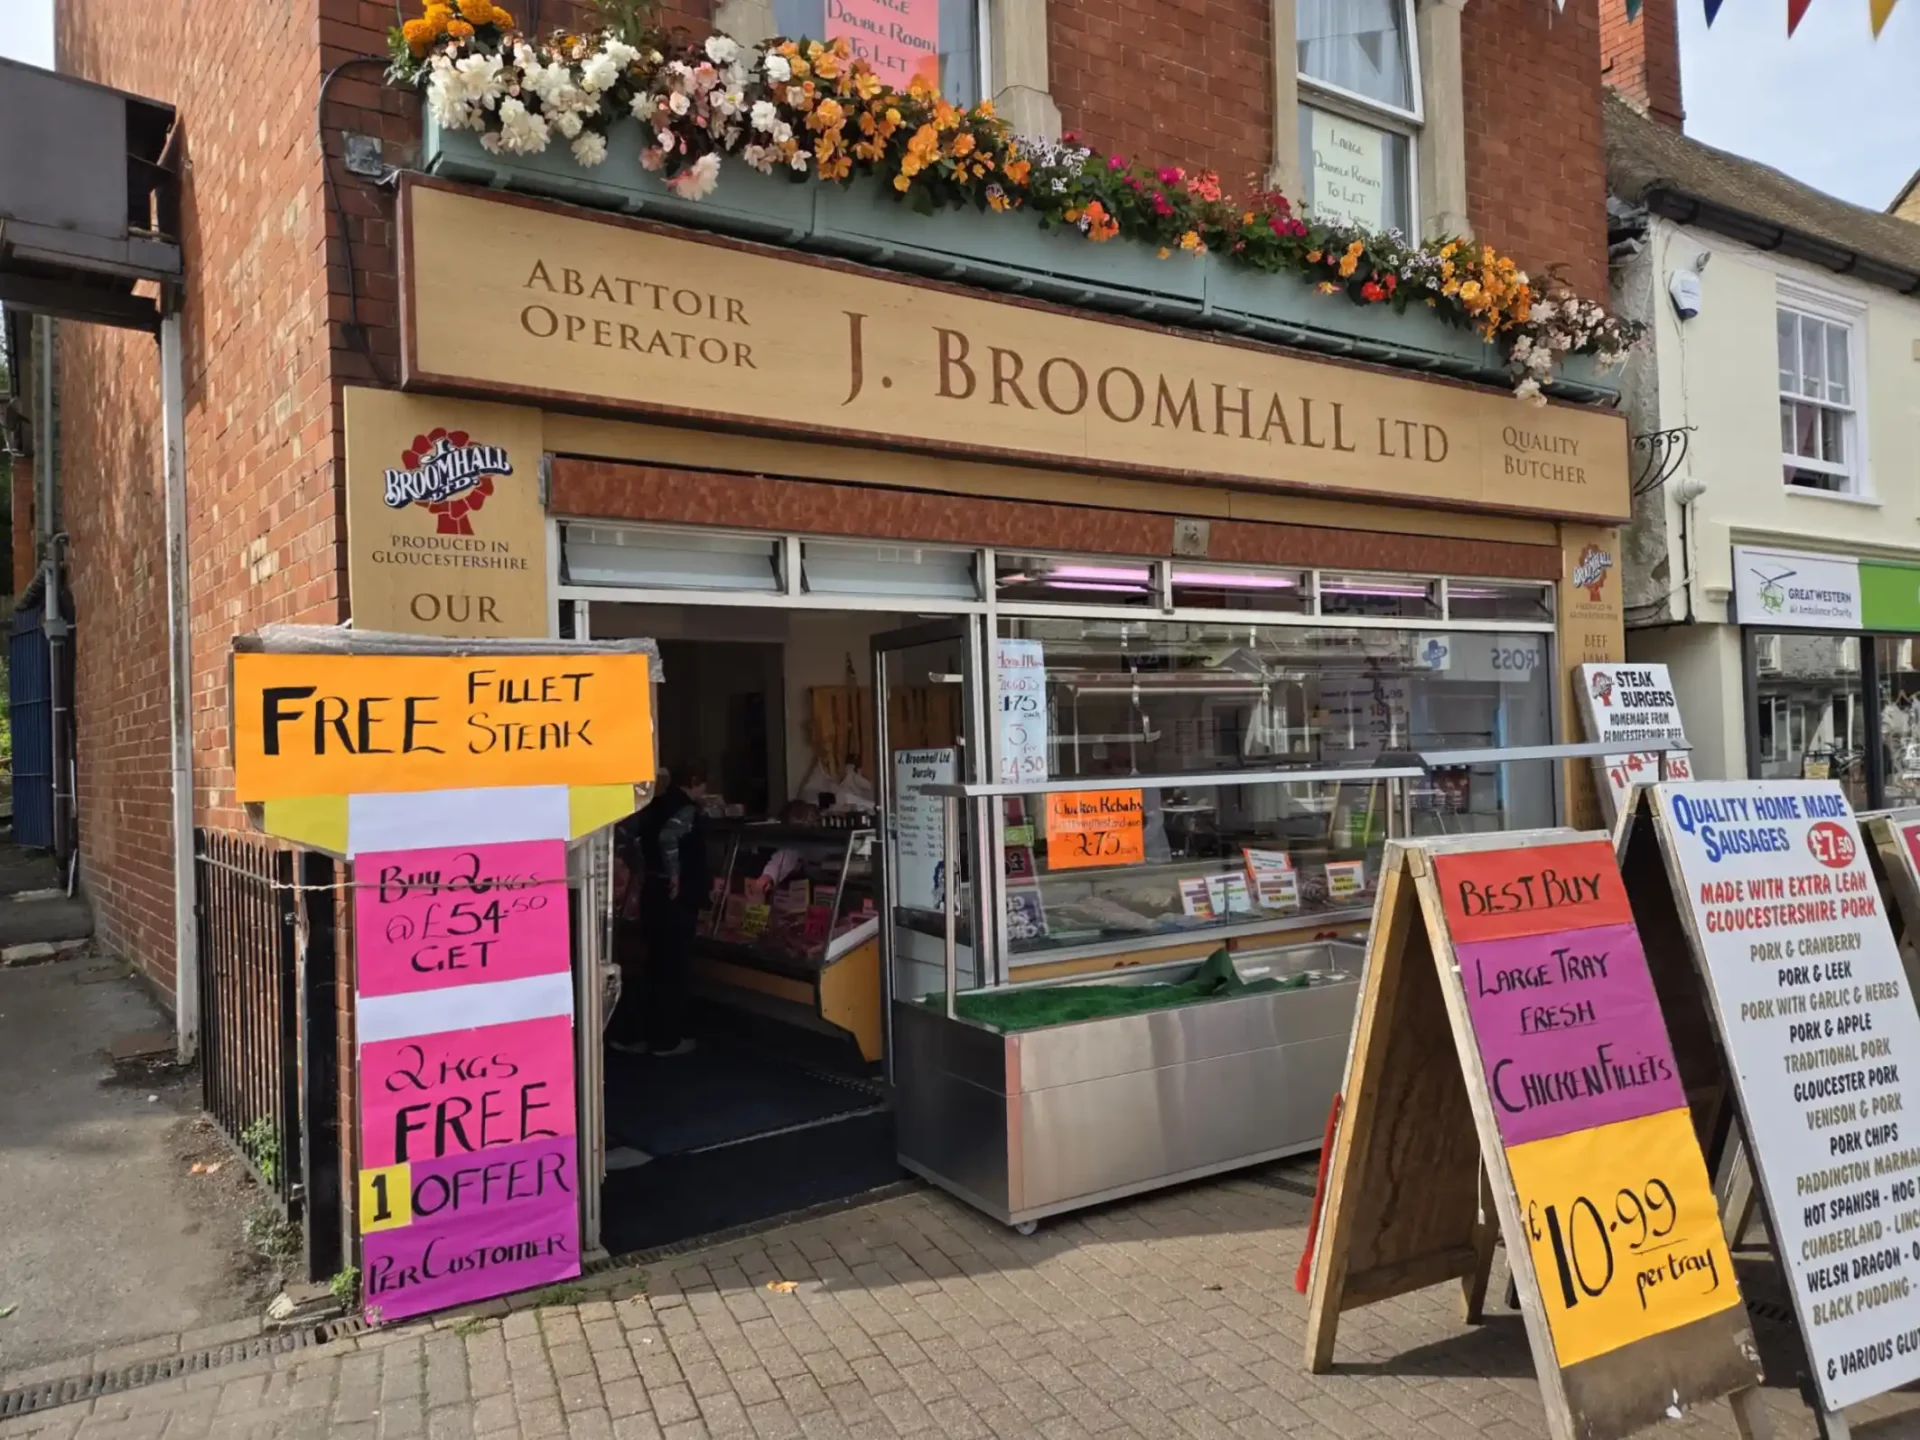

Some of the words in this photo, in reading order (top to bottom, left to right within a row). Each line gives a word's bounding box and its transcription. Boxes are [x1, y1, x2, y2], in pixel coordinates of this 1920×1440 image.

[875, 44, 907, 73] LET
[1342, 185, 1366, 205] LET
[523, 259, 752, 325] ABATTOIR
[520, 305, 757, 368] OPERATOR
[840, 310, 892, 406] J.
[932, 326, 1355, 453] BROOMHALL
[1376, 417, 1449, 463] LTD
[1503, 425, 1579, 457] QUALITY
[384, 446, 511, 507] BROOMHALL
[1503, 455, 1586, 484] BUTCHER
[372, 551, 528, 570] GLOUCESTERSHIRE
[392, 535, 486, 552] PRODUCED
[491, 541, 509, 552] IN
[410, 593, 503, 623] OUR
[1788, 588, 1814, 600] GREAT
[1815, 590, 1851, 604] WESTERN
[1584, 634, 1608, 648] BEEF
[468, 669, 594, 705] FILLET
[1616, 671, 1655, 688] STEAK
[1621, 691, 1675, 708] BURGERS
[262, 686, 446, 756] FREE
[467, 712, 594, 754] STEAK
[1009, 724, 1027, 745] 3
[1604, 729, 1665, 743] GLOUCESTERSHIRE
[1610, 712, 1649, 726] HOMEMADE
[1651, 712, 1670, 724] FROM
[906, 751, 938, 765] Broomhall
[1672, 794, 1750, 835] QUALITY
[1755, 796, 1801, 820] HOME
[1803, 794, 1847, 818] MADE
[1701, 825, 1790, 863] SAUSAGES
[1459, 875, 1533, 917] BEST
[1540, 868, 1601, 909] BUY
[1701, 881, 1743, 905] MADE
[1749, 878, 1784, 900] WITH
[1789, 874, 1832, 897] EXTRA
[1835, 871, 1867, 893] LEAN
[1706, 900, 1837, 933] GLOUCESTERSHIRE
[1841, 896, 1877, 918] PORK
[411, 939, 499, 972] GET
[1750, 940, 1783, 962] PORK
[1786, 940, 1795, 957] &
[1798, 933, 1861, 957] CRANBERRY
[1477, 958, 1553, 998] LARGE
[1551, 948, 1610, 983] TRAY
[1778, 966, 1810, 987] PORK
[1813, 964, 1822, 982] &
[1825, 960, 1852, 980] LEEK
[1519, 1000, 1596, 1032] FRESH
[1741, 1001, 1775, 1021] PORK
[1776, 995, 1807, 1015] WITH
[1810, 989, 1850, 1011] GARLIC
[1853, 986, 1862, 1004] &
[1865, 980, 1899, 1000] HERBS
[1790, 1021, 1821, 1043] PORK
[1824, 1019, 1834, 1037] &
[1837, 1013, 1872, 1035] APPLE
[1783, 1044, 1859, 1074] TRADITIONAL
[1861, 1037, 1892, 1060] PORK
[1794, 1070, 1866, 1102] GLOUCESTER
[1869, 1064, 1900, 1087] PORK
[396, 1081, 559, 1164] FREE
[1806, 1103, 1857, 1130] VENISON
[1860, 1099, 1869, 1118] &
[1872, 1092, 1903, 1116] PORK
[1830, 1131, 1862, 1156] PORK
[1865, 1123, 1898, 1147] CHIPS
[371, 1174, 391, 1222] 1
[412, 1152, 570, 1216] OFFER
[1796, 1160, 1871, 1196] PADDINGTON
[1804, 1202, 1826, 1227] HOT
[1830, 1189, 1880, 1220] SPANISH
[1892, 1179, 1915, 1202] HOG
[1802, 1220, 1882, 1260] CUMBERLAND
[1636, 1265, 1666, 1311] per
[1668, 1249, 1719, 1295] tray
[1807, 1262, 1849, 1293] WELSH
[1852, 1246, 1901, 1280] DRAGON
[1813, 1294, 1854, 1326] BLACK
[1857, 1276, 1909, 1312] PUDDING
[1827, 1358, 1837, 1381] &
[1840, 1338, 1893, 1376] VARIOUS
